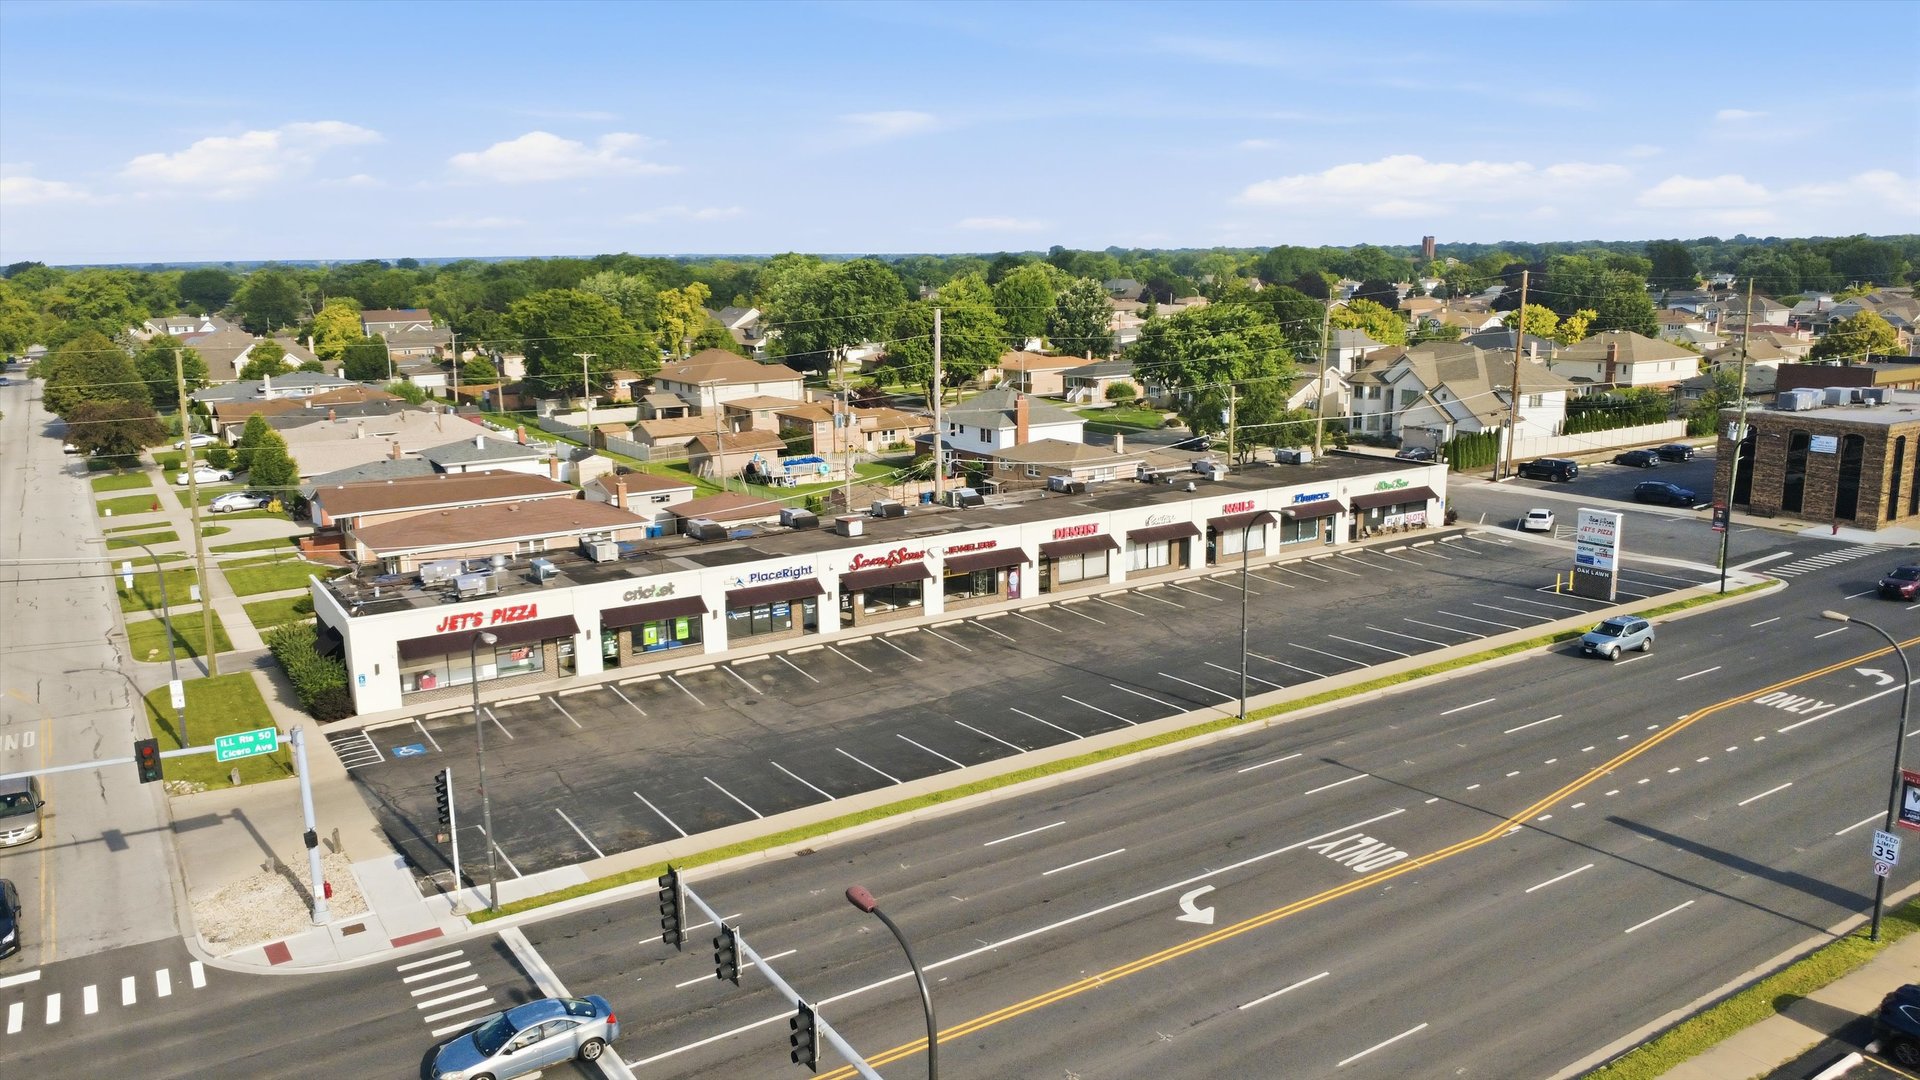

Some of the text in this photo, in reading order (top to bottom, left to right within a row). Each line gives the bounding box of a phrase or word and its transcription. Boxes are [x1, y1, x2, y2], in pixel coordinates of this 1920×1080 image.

[1222, 500, 1254, 515] NAILS
[1406, 512, 1425, 523] SLOTS
[1053, 523, 1099, 540] DENTIST
[1597, 528, 1613, 536] PIZZA
[945, 540, 997, 555] JEWELERS
[749, 565, 813, 583] PlaceRight
[1576, 567, 1609, 578] OAK LAWN
[623, 582, 675, 602] cricket
[436, 604, 538, 632] JET'S PIZZA
[1753, 691, 1836, 715] ONLY
[239, 735, 254, 744] Rte
[257, 731, 271, 740] 50
[222, 743, 273, 759] Cicero Ave
[1876, 832, 1898, 844] SPEED
[1877, 839, 1894, 849] LIMIT
[1307, 833, 1409, 873] ONLY
[1874, 845, 1895, 861] 35
